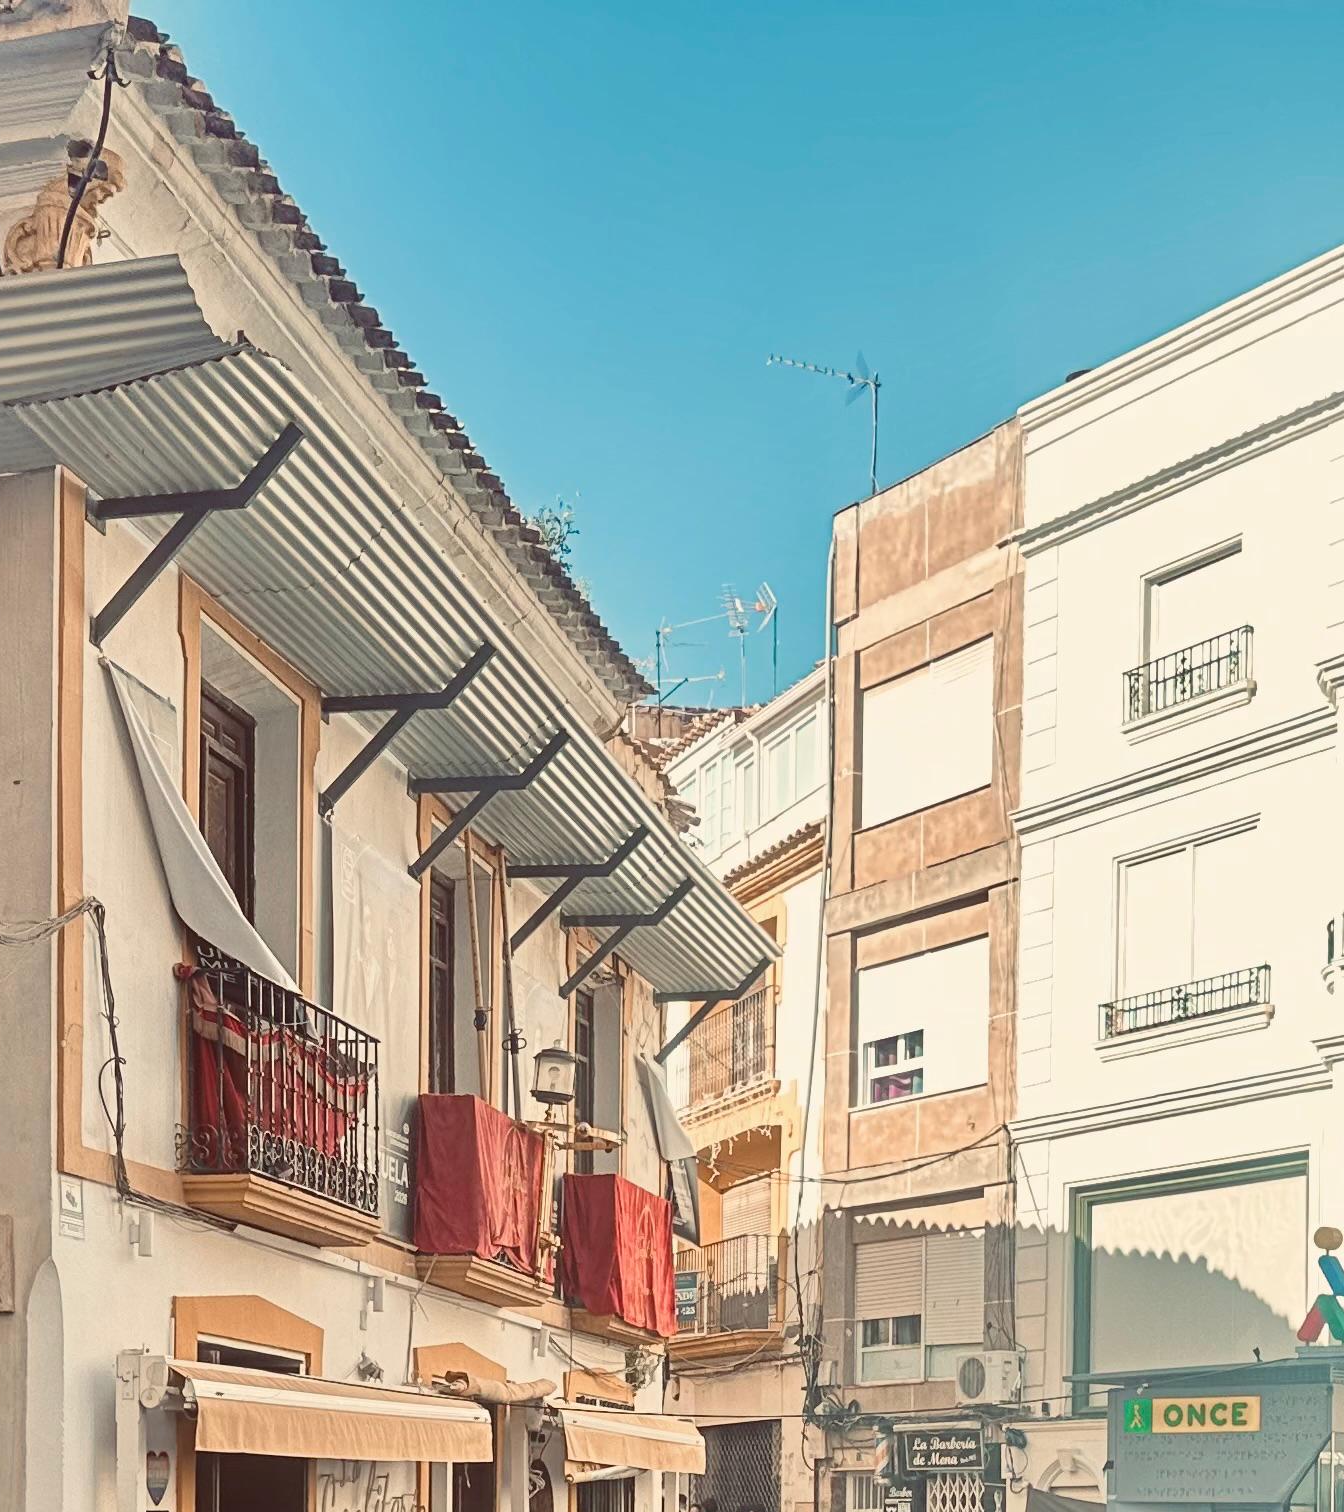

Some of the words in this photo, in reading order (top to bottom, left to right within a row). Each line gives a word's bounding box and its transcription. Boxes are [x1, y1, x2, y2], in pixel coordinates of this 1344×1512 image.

[1162, 1402, 1249, 1427] ONCE
[912, 1437, 928, 1451] La
[912, 1453, 926, 1465] de
[927, 1452, 959, 1466] Mena
